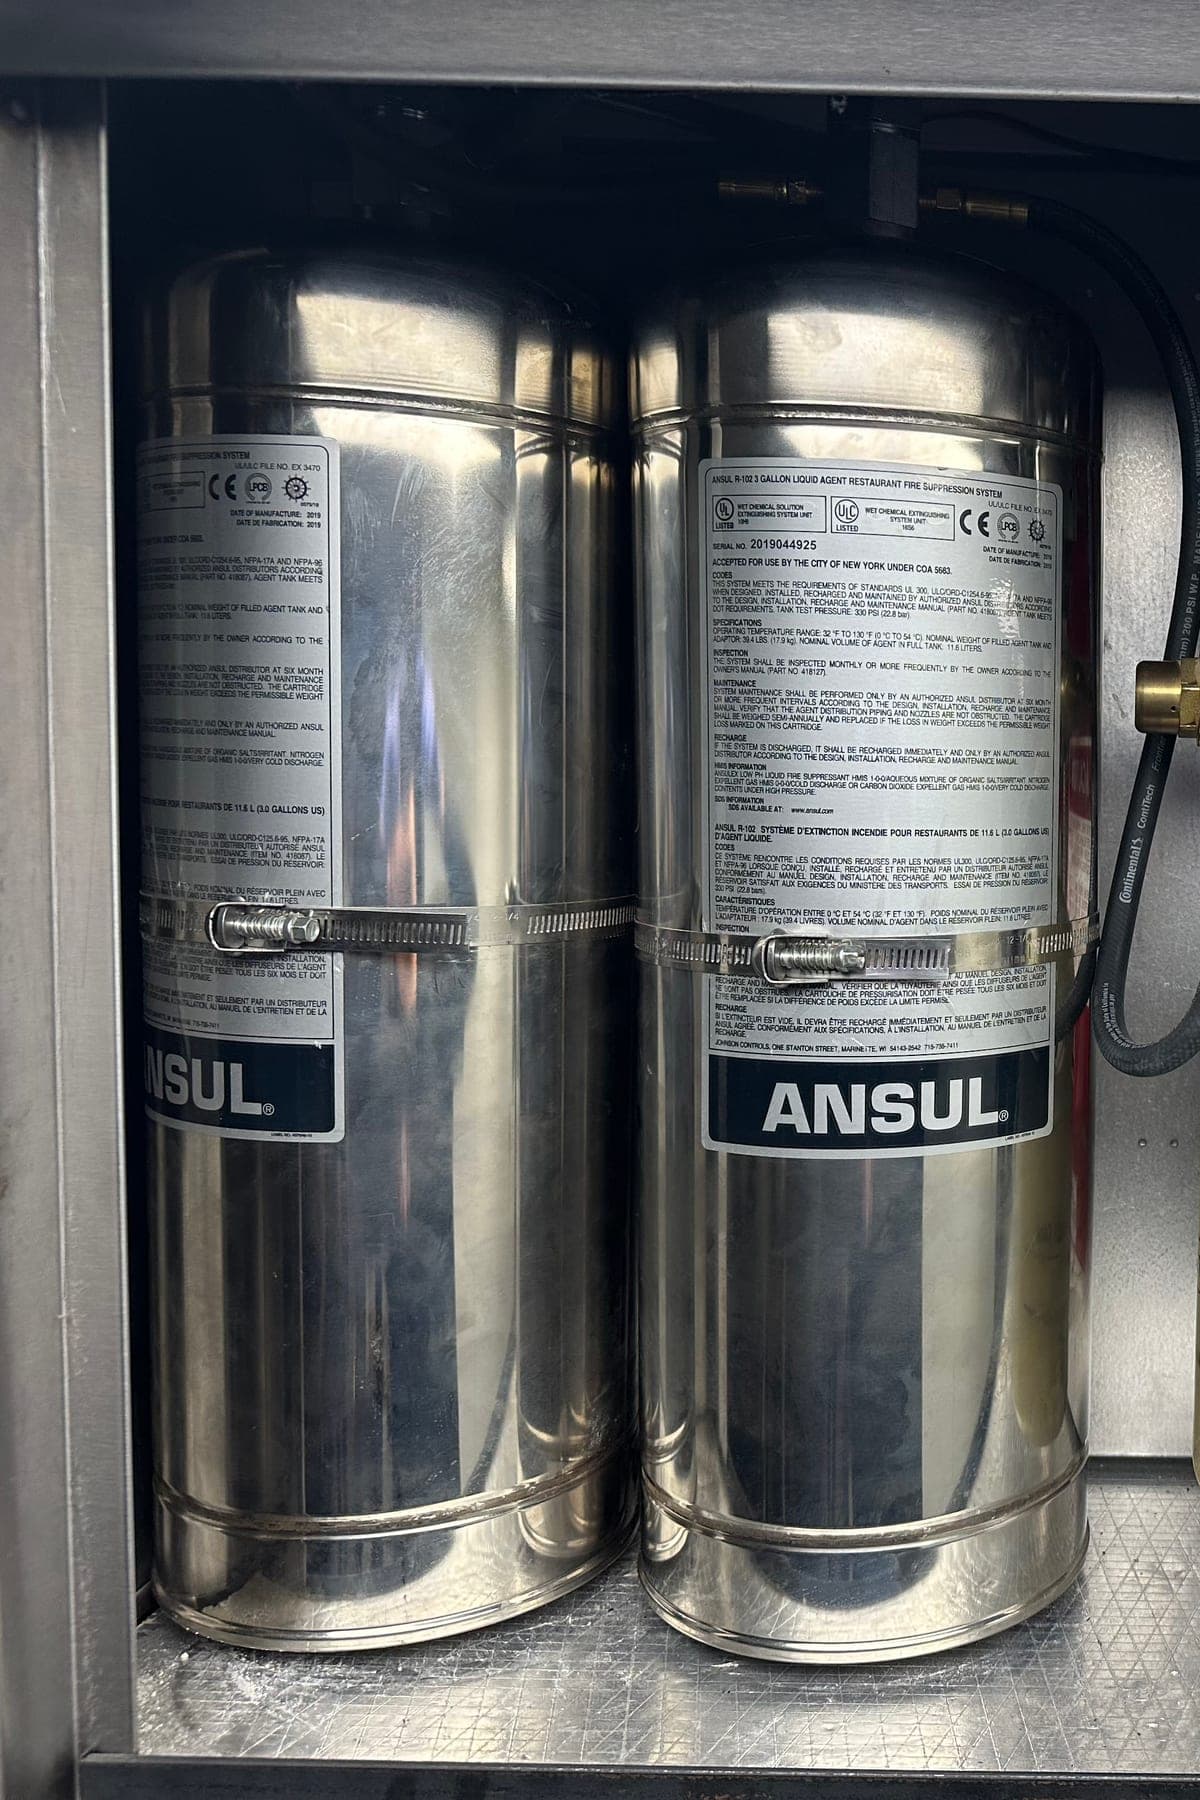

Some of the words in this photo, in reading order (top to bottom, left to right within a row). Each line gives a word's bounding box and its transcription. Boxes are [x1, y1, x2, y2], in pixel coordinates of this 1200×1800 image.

[260, 462, 275, 470] FILE
[712, 476, 734, 484] ANSUL
[760, 475, 790, 484] GALLON
[792, 476, 818, 484] LIQUID
[820, 476, 848, 485] AGENT
[849, 477, 902, 488] RESTAURANT
[904, 481, 920, 490] FIRE
[923, 482, 975, 496] SUPPRESSION
[976, 486, 1003, 498] SYSTEM
[836, 524, 858, 532] LISTED
[960, 509, 990, 538] CE
[750, 538, 817, 550] 2019044925
[712, 558, 747, 566] ACCEPTED
[764, 558, 780, 566] USE
[781, 558, 792, 566] BY
[794, 559, 809, 567] THE
[810, 560, 828, 568] CITY
[830, 560, 840, 568] OF
[843, 560, 860, 569] NEW
[863, 561, 886, 571] YORK
[887, 562, 914, 572] UNDER
[916, 564, 932, 574] COA
[776, 580, 790, 588] THE
[792, 581, 846, 590] REQUIREMENTS
[861, 583, 902, 593] STANDARDS
[1189, 570, 1200, 594] W.P.
[803, 590, 850, 599] RECHARGED
[308, 606, 324, 614] AND
[1186, 596, 1197, 614] PSI
[747, 628, 795, 636] TEMPERATURE
[1182, 616, 1193, 636] 200
[296, 636, 306, 644] TO
[831, 638, 860, 646] VOLUME
[906, 642, 924, 650] FULL
[788, 659, 826, 668] INSPECTED
[830, 660, 862, 670] MONTHLY
[866, 662, 876, 670] OR
[880, 662, 900, 670] MORE
[904, 663, 948, 673] FREQUENTLY
[950, 665, 958, 673] BY
[977, 666, 999, 675] OWNER
[713, 680, 756, 688] MAINTENANCE
[300, 722, 324, 731] ANSUL
[272, 804, 308, 814] GALLONS
[311, 805, 326, 816] US)
[714, 824, 736, 832] ANSUL
[738, 824, 756, 832] R-102
[761, 824, 794, 834] SYSTÈME
[797, 826, 849, 836] D'EXTINCTION
[852, 828, 888, 837] INCENDIE
[890, 828, 912, 837] POUR
[914, 829, 968, 838] RESTAURANTS
[970, 829, 980, 837] DE
[1119, 846, 1142, 904] Continental
[1136, 783, 1156, 830] ContiTech
[144, 1044, 263, 1115] NSUL
[761, 1077, 1000, 1135] ANSUL
